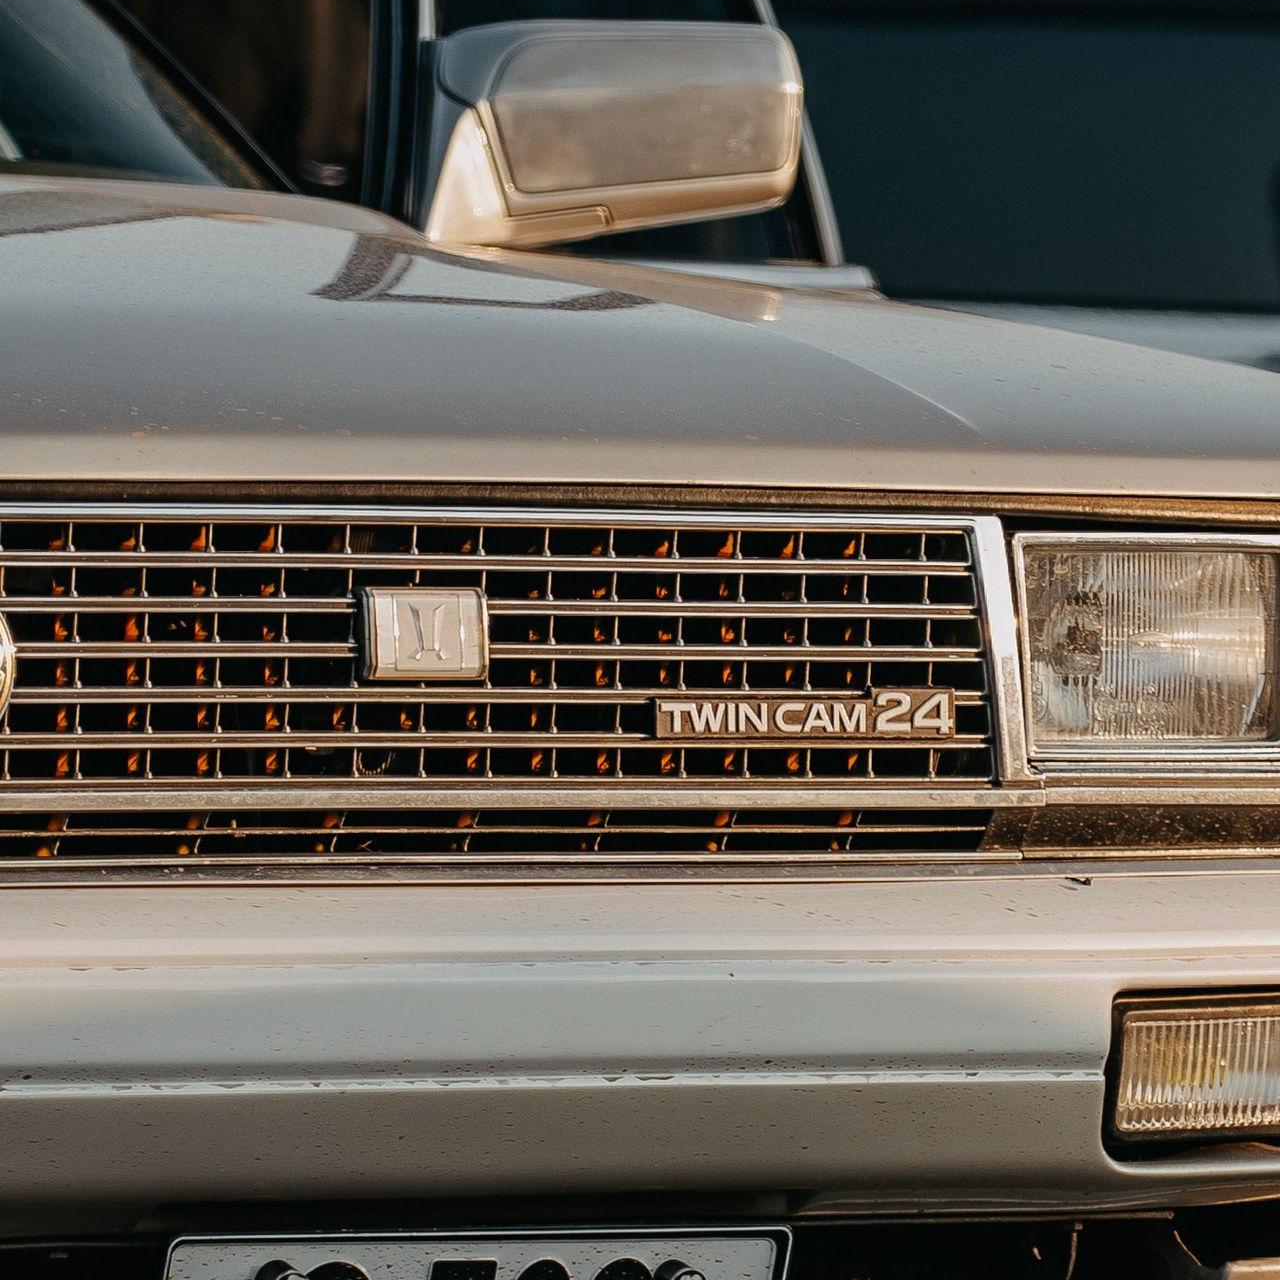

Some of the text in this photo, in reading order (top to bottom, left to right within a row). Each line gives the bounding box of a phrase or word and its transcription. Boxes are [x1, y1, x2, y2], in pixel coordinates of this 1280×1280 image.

[659, 692, 953, 734] TWIN CAM 24
